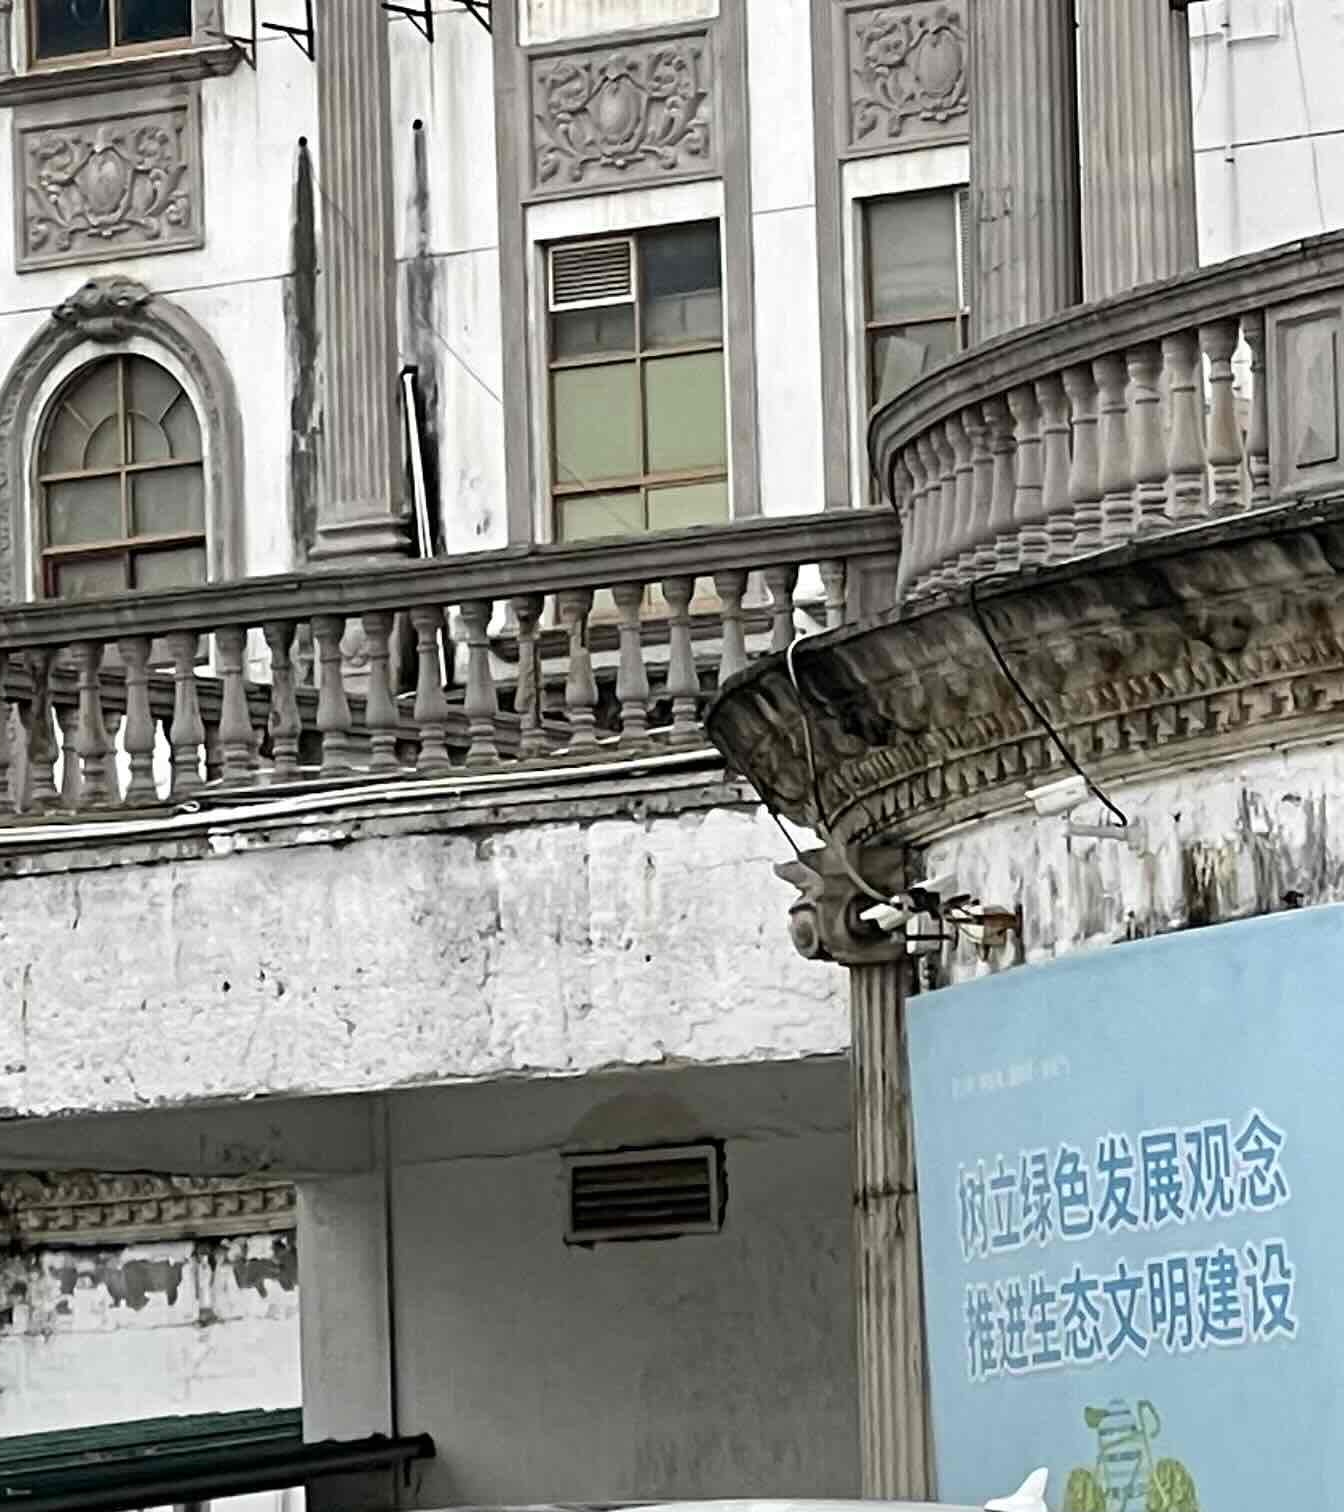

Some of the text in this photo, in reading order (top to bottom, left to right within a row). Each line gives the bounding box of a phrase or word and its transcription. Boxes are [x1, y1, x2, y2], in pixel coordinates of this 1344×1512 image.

[958, 1110, 1288, 1258] 树立绿色发展观念
[966, 1243, 1298, 1378] 推进生态文明建设
